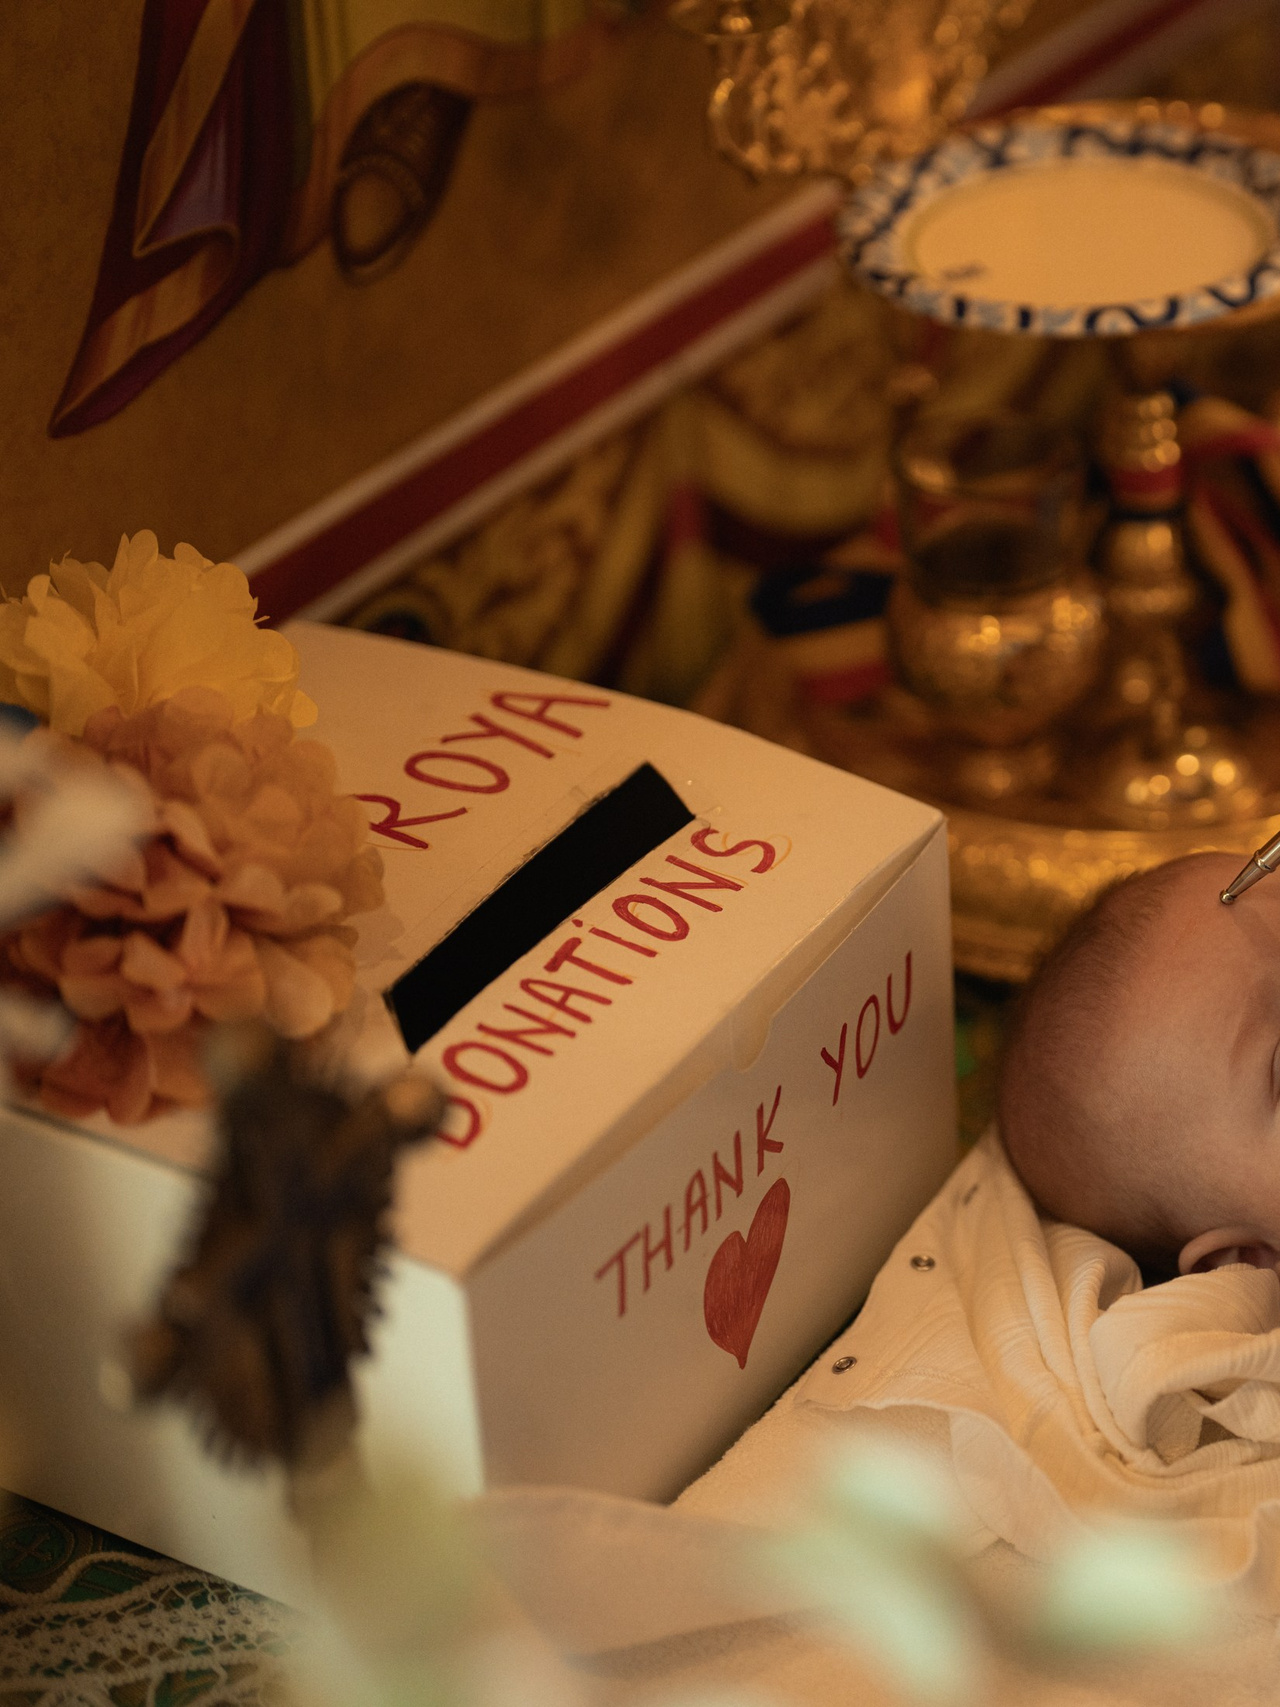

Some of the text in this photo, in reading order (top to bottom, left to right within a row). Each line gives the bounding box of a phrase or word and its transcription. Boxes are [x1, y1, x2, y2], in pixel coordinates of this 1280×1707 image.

[353, 690, 611, 850] ROYA
[594, 951, 913, 1318] THANK YOU
